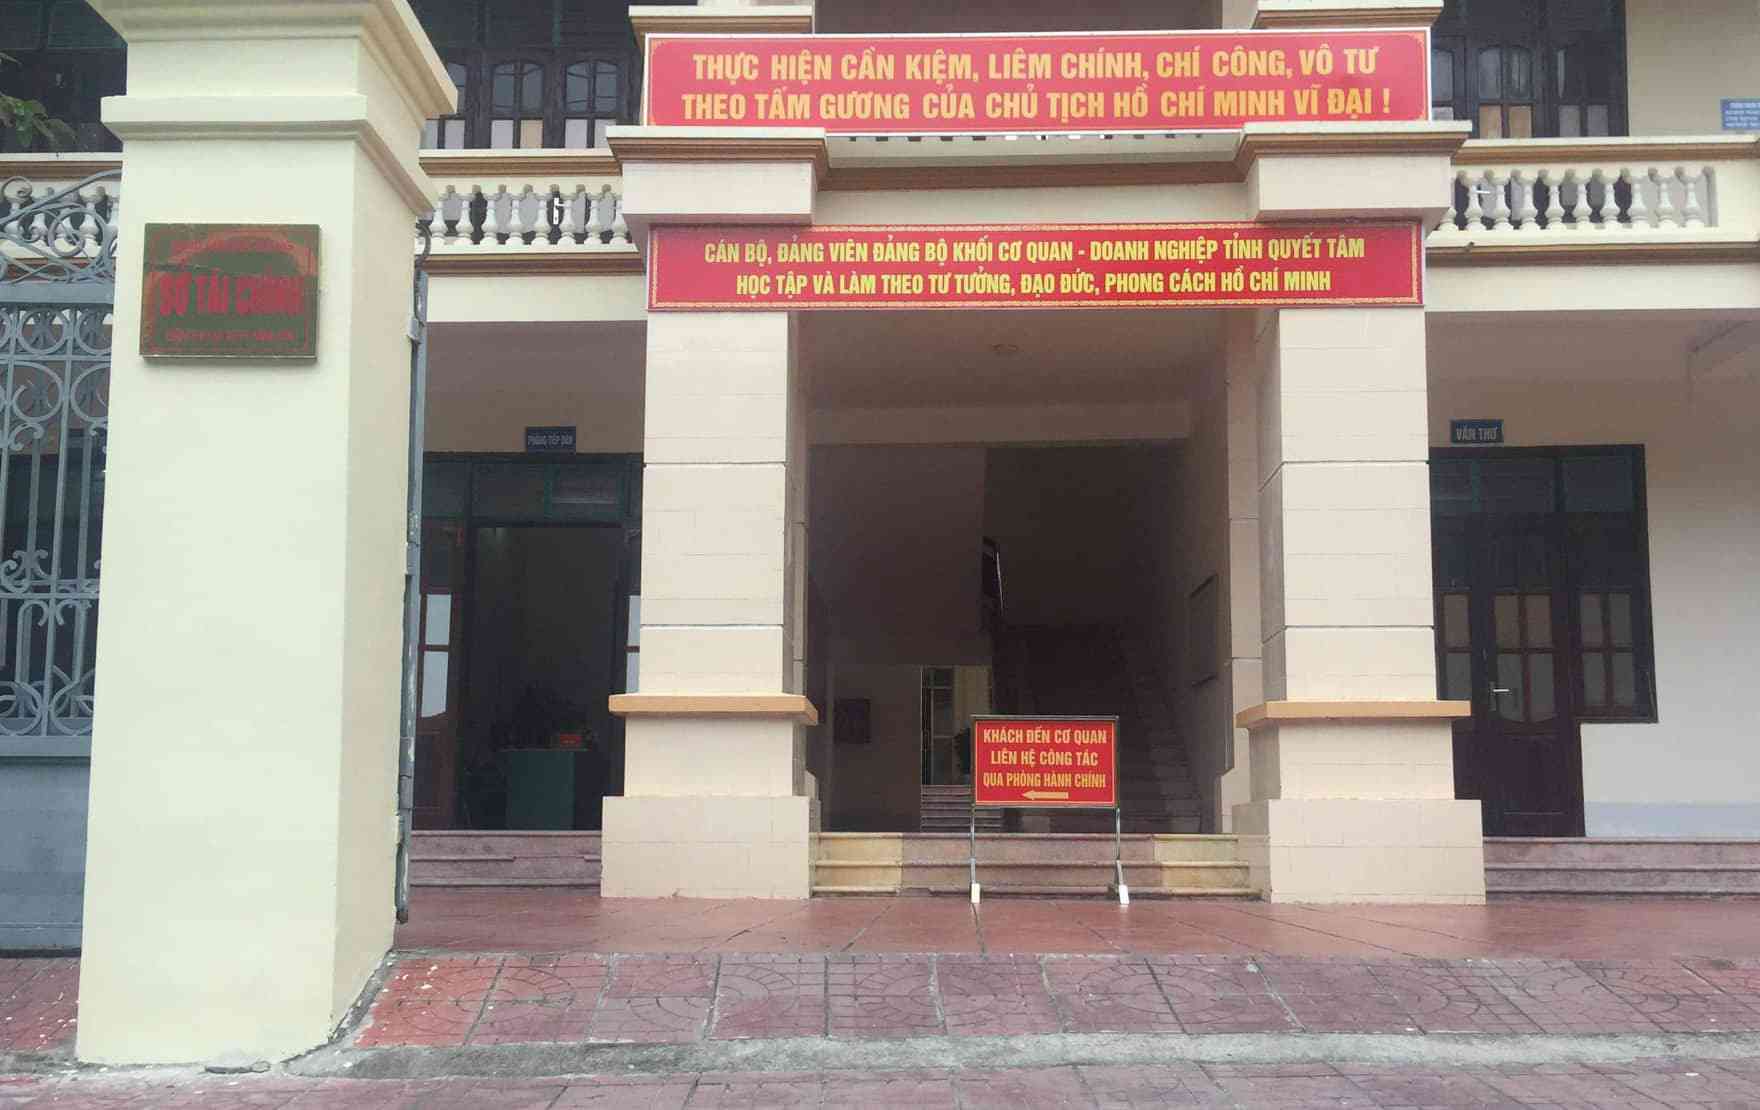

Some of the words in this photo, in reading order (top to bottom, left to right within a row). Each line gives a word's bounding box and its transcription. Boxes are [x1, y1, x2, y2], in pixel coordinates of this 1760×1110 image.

[693, 52, 759, 85] THỰC
[771, 50, 832, 85] HIỆN
[841, 46, 894, 80] CẦN
[905, 49, 979, 84] KIỆM,
[988, 48, 1051, 79] LIÊM
[1061, 47, 1149, 80] CHÍNH,
[1156, 45, 1200, 77] CHÍ
[1212, 45, 1293, 79] CÔNG,
[1299, 43, 1333, 75] VÔ
[1344, 46, 1380, 74] TƯ
[681, 94, 746, 119] THEO
[754, 86, 811, 119] TẤM
[819, 90, 909, 119] GƯƠNG
[922, 83, 975, 118] CỦA
[985, 83, 1038, 118] CHỦ
[1047, 91, 1104, 123] TỊCH
[1113, 83, 1148, 117] HỒ
[1161, 86, 1205, 117] CHÍ
[1213, 90, 1285, 116] MINH
[1293, 84, 1321, 115] VĨ
[1328, 88, 1372, 119] ĐẠI
[704, 239, 739, 263] CÁN
[744, 239, 772, 267] BỘ,
[777, 235, 824, 262] ĐẢNG
[829, 239, 868, 262] VIÊN
[873, 234, 920, 262] ĐẢNG
[925, 238, 948, 266] BỘ
[953, 235, 993, 261] KHỐI
[998, 240, 1022, 261] CƠ
[1026, 241, 1073, 263] QUAN
[1090, 241, 1149, 261] DOANH
[1154, 236, 1218, 264] NGHIỆP
[1223, 232, 1263, 260] TỈNH
[1268, 232, 1321, 261] QUYẾT
[1327, 235, 1364, 258] TÂM
[736, 274, 771, 298] HỌC
[775, 270, 808, 299] TẬP
[812, 270, 834, 294] VÀ
[839, 270, 876, 294] LÀM
[881, 274, 923, 294] THEO
[928, 272, 952, 293] TƯ
[955, 265, 1015, 296] TƯỞNG,
[1020, 273, 1055, 298] ĐẠO
[1060, 268, 1100, 296] ĐỨC,
[1105, 273, 1164, 294] PHONG
[1169, 268, 1216, 293] CÁCH
[1221, 265, 1244, 291] HỒ
[1250, 266, 1280, 291] CHÍ
[1284, 271, 1331, 291] MINH
[984, 726, 1023, 744] KHÁCH
[1026, 725, 1051, 744] ĐẾN
[1054, 728, 1071, 744] CƠ
[1074, 730, 1107, 745] QUAN
[991, 747, 1017, 765] LIÊN
[1021, 748, 1036, 768] HỆ
[1039, 748, 1073, 766] CÔNG
[1076, 748, 1099, 766] TÁC
[983, 773, 1004, 788] QUA
[1007, 771, 1041, 787] PHÒNG
[1044, 771, 1072, 787] HÀNH
[1075, 770, 1106, 788] CHÍNH
